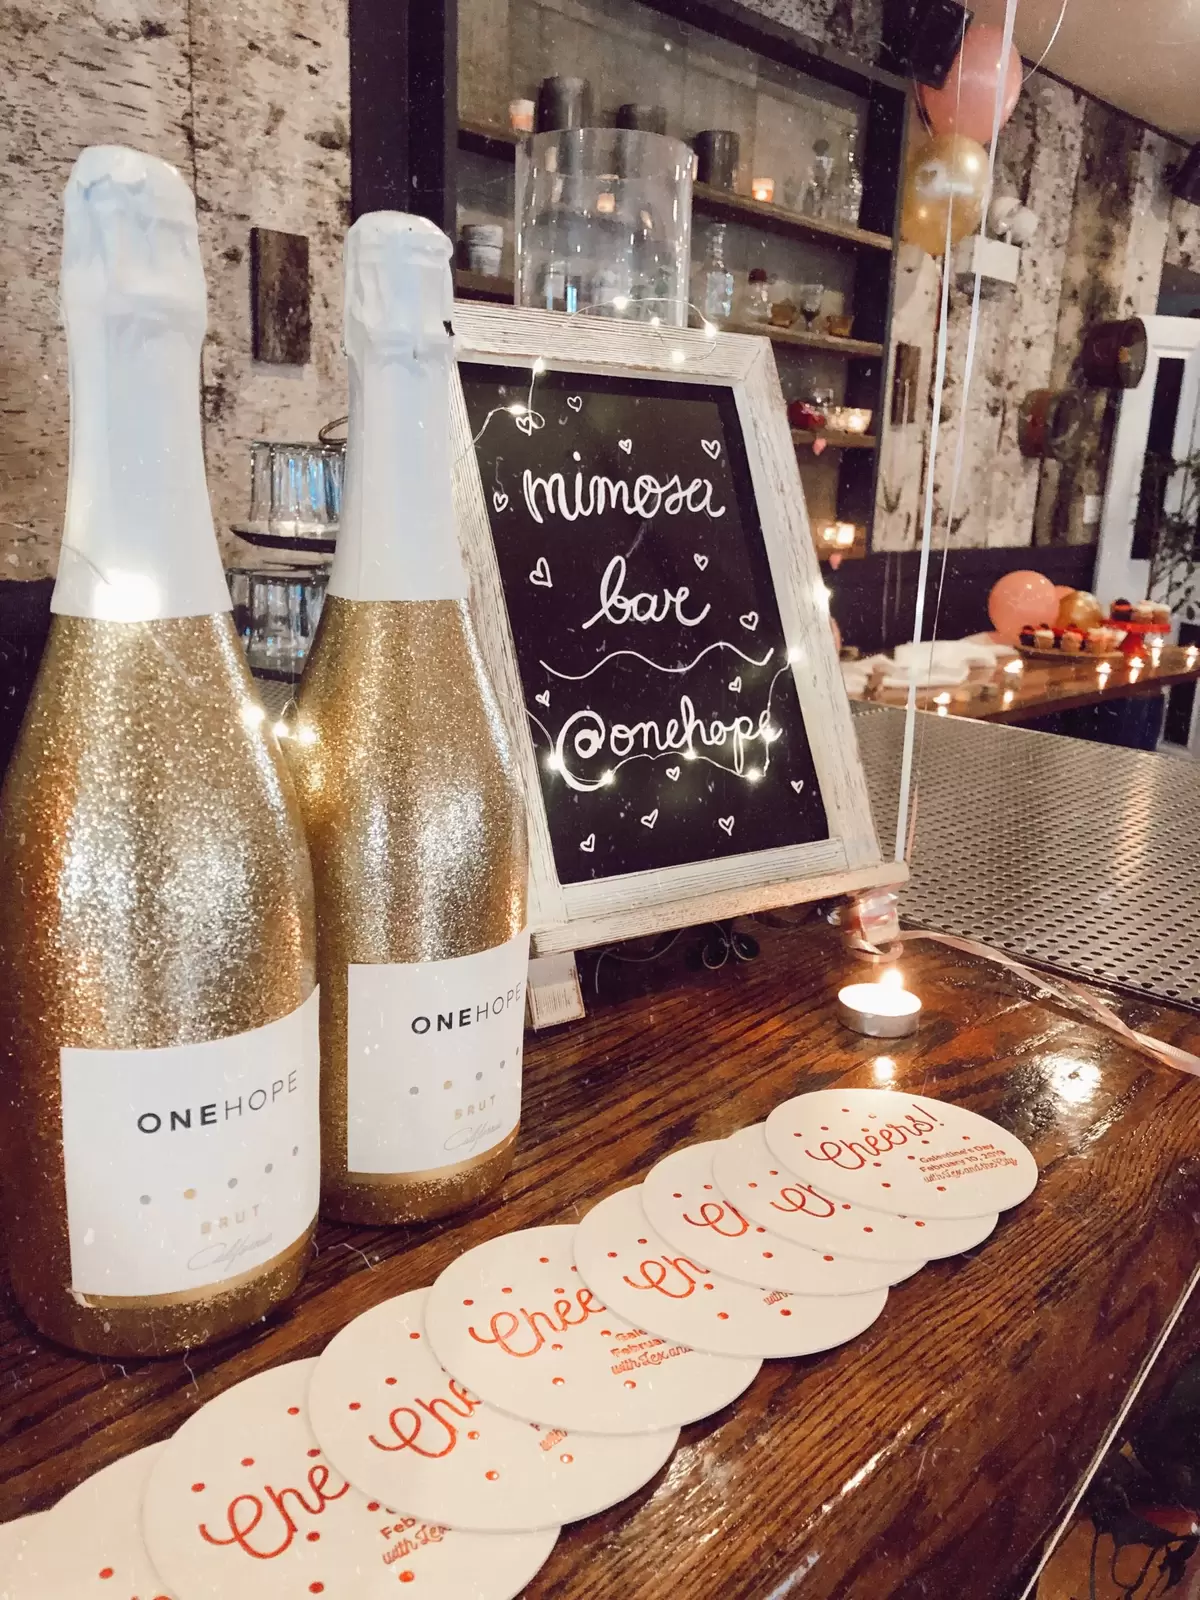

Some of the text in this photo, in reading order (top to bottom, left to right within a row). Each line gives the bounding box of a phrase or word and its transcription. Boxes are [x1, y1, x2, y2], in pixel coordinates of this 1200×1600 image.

[522, 451, 726, 524] mimosa
[582, 555, 711, 630] bar
[556, 695, 783, 791] @onehope
[410, 981, 523, 1035] ONEHOPE
[136, 1068, 298, 1135] ONEHOPE
[454, 1093, 497, 1121] BRUT
[804, 1103, 945, 1170] Cheers!
[973, 1144, 995, 1152] Day
[919, 1158, 966, 1173] February
[200, 1203, 260, 1235] BRUT
[610, 1358, 642, 1376] with
[382, 1538, 419, 1566] with
